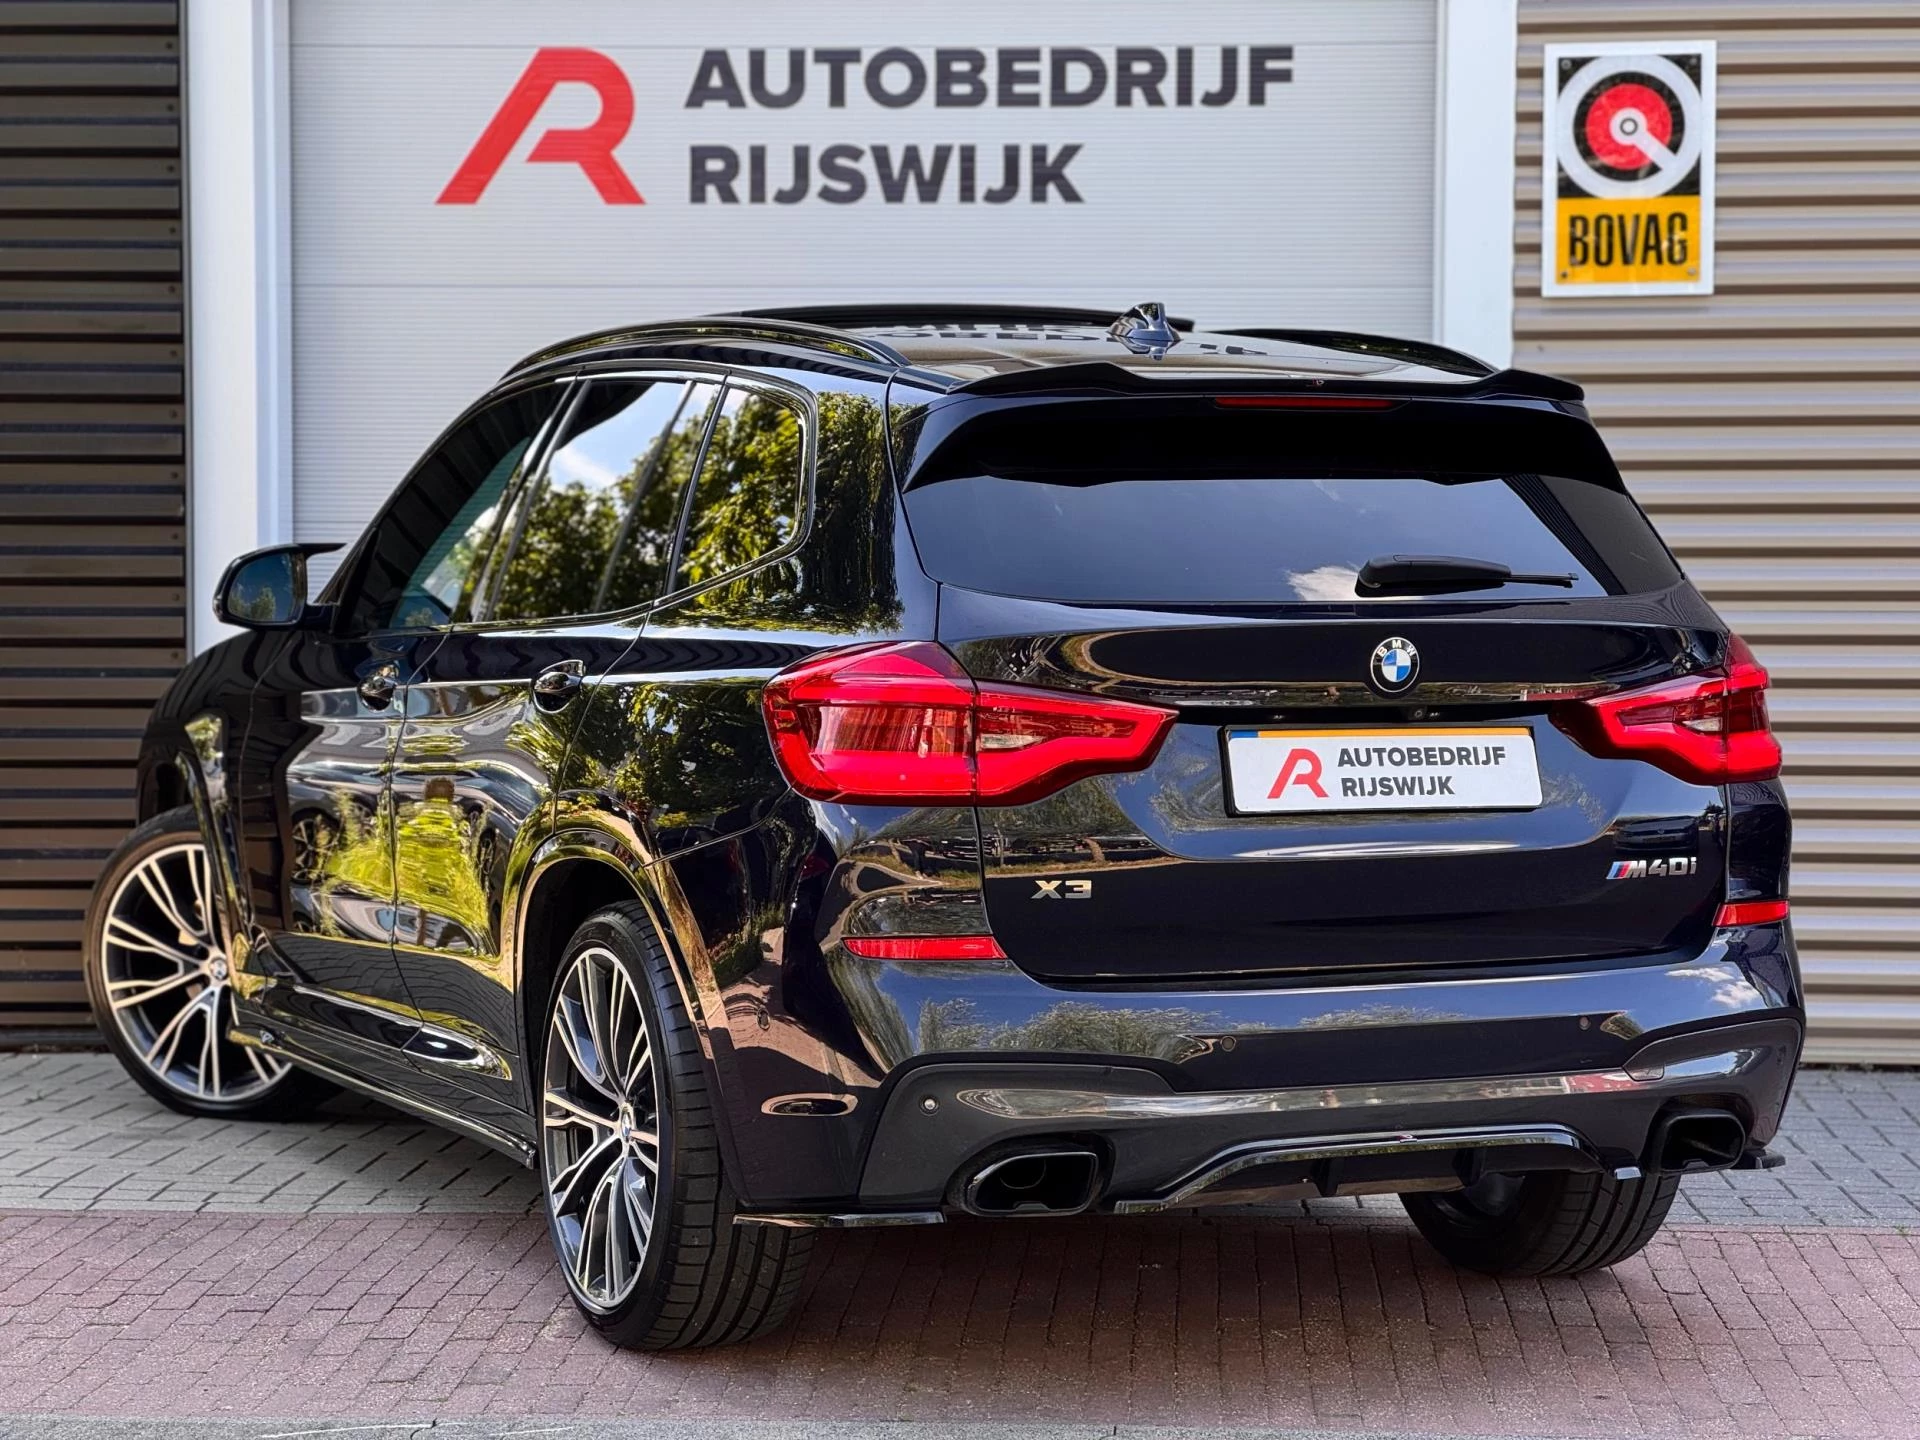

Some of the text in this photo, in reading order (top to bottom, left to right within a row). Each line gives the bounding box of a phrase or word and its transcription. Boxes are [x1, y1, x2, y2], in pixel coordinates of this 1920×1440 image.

[685, 46, 1294, 109] AUTOBEDRIJF
[689, 143, 1085, 204] RIJSWIJK
[1569, 212, 1688, 267] BOVAG
[1376, 639, 1417, 658] BMW
[1338, 746, 1506, 767] AUTOBEDRIJF
[1341, 776, 1455, 797] RIJSWIJK
[1618, 857, 1697, 879] M40i
[1031, 880, 1092, 899] X3
